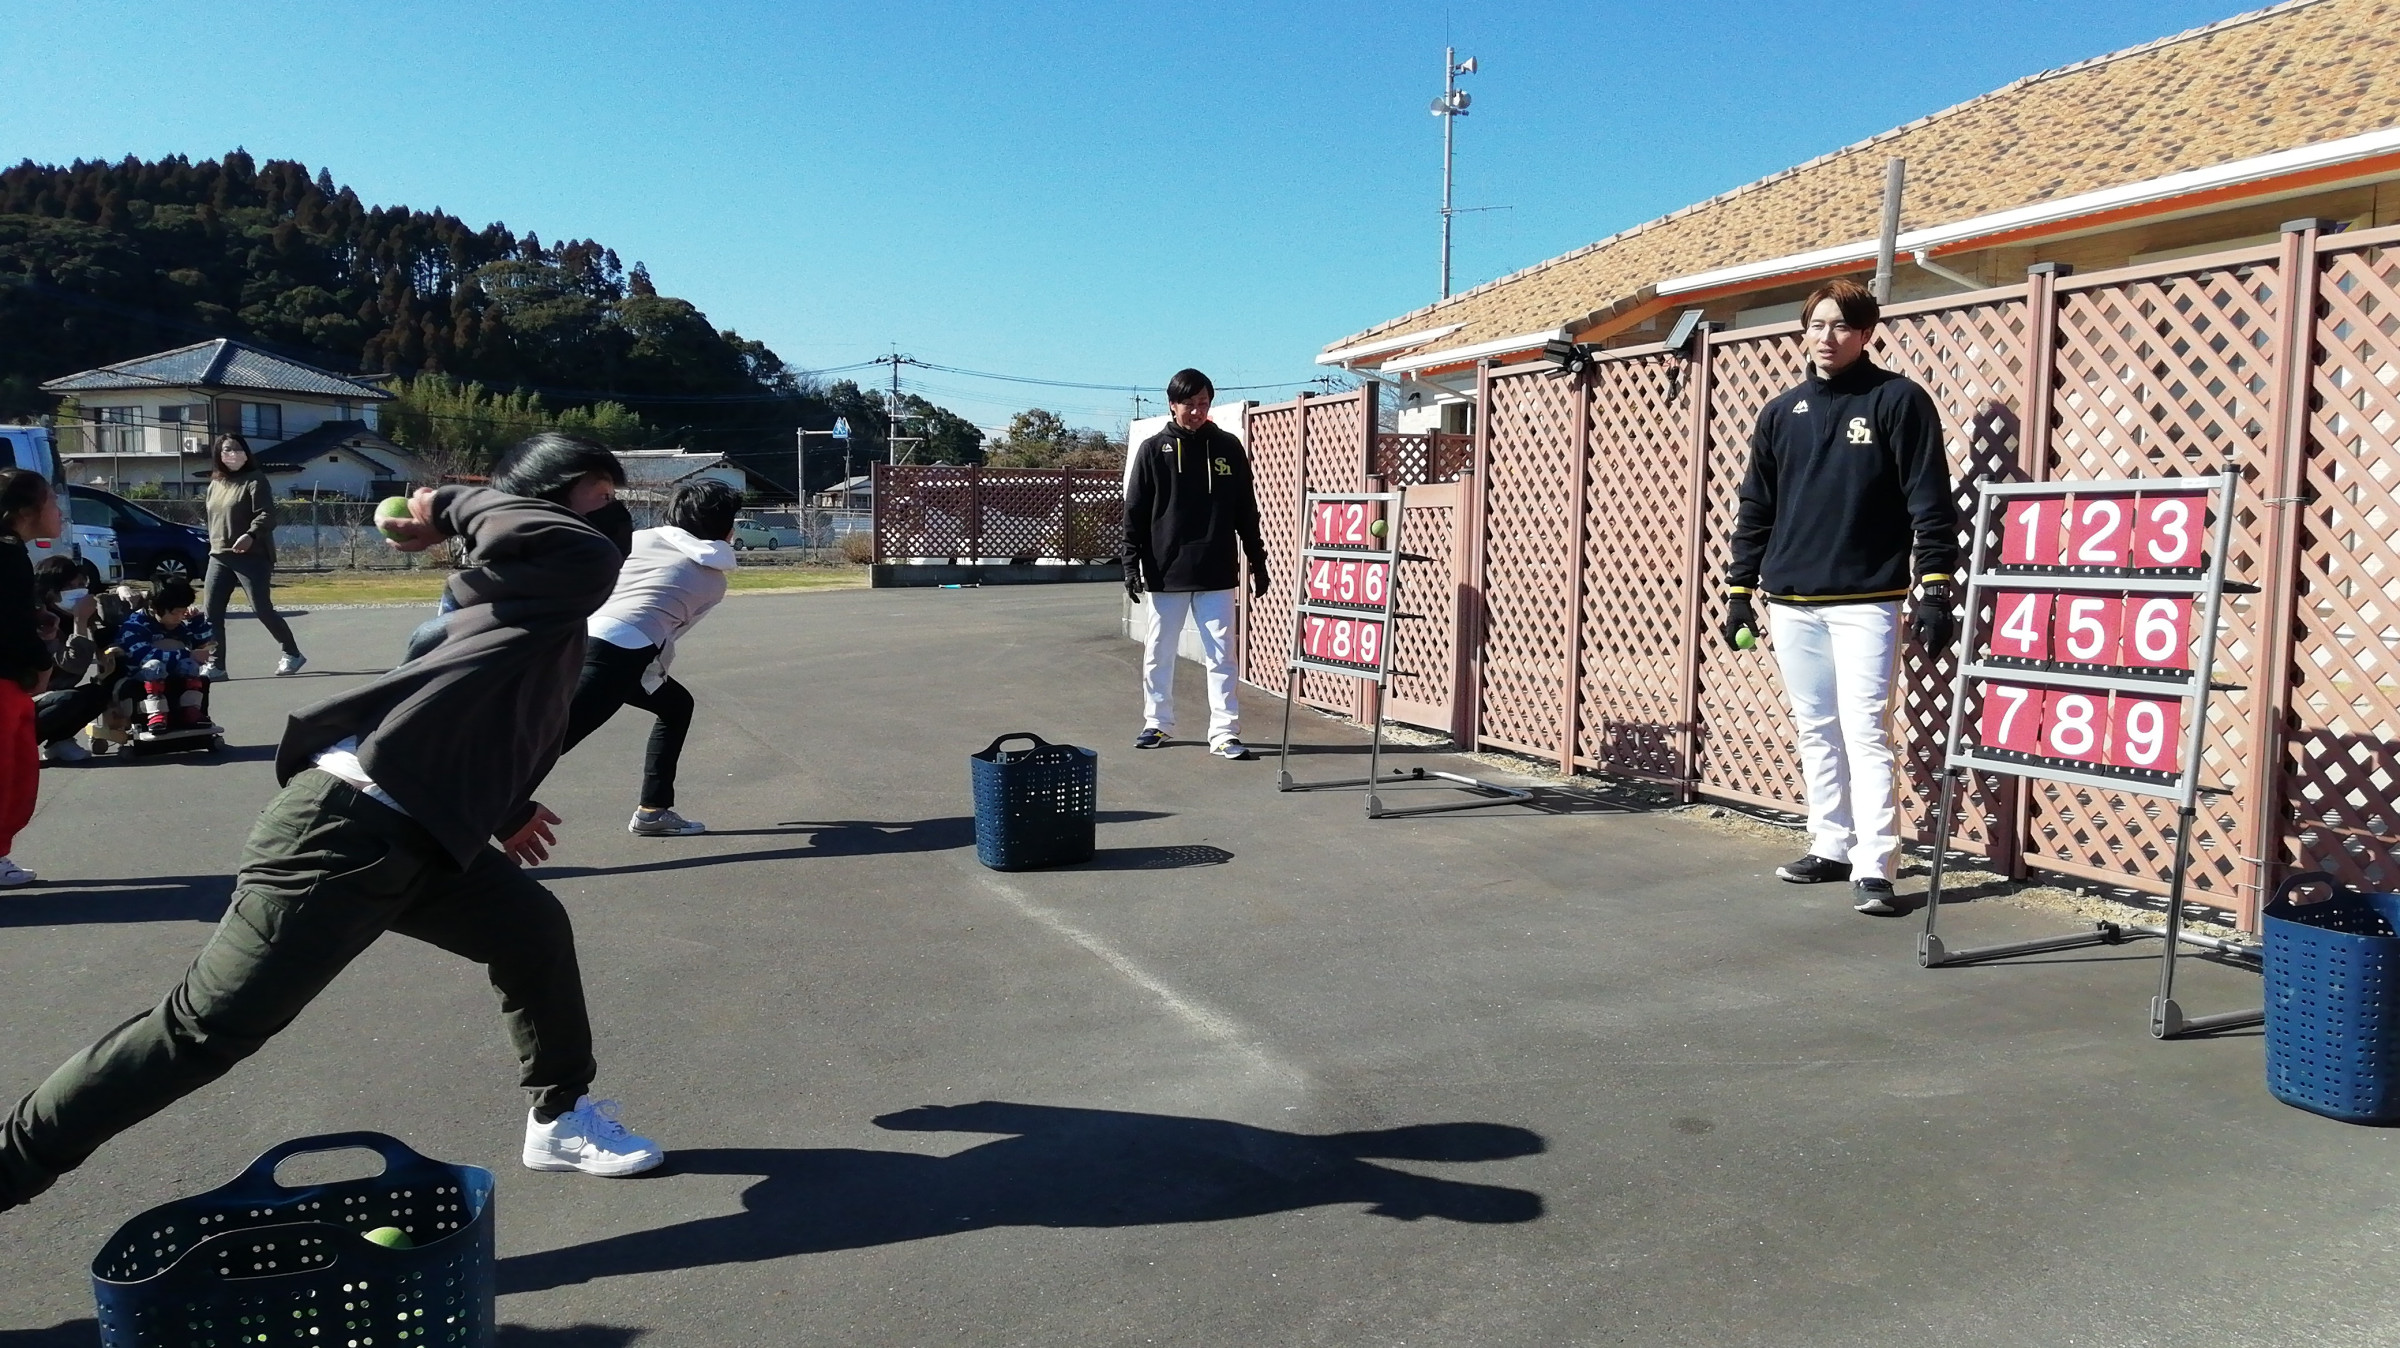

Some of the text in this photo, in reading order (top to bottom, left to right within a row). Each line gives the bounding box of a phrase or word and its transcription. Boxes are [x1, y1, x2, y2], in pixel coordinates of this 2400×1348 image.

[1322, 503, 1363, 542] 1 2
[2018, 499, 2189, 564] 1 2 3
[1313, 560, 1383, 602] 4 5 6
[1311, 617, 1377, 662] 7 8 9
[2000, 593, 2179, 662] 4 5 6
[1995, 685, 2164, 766] 7 8 9
